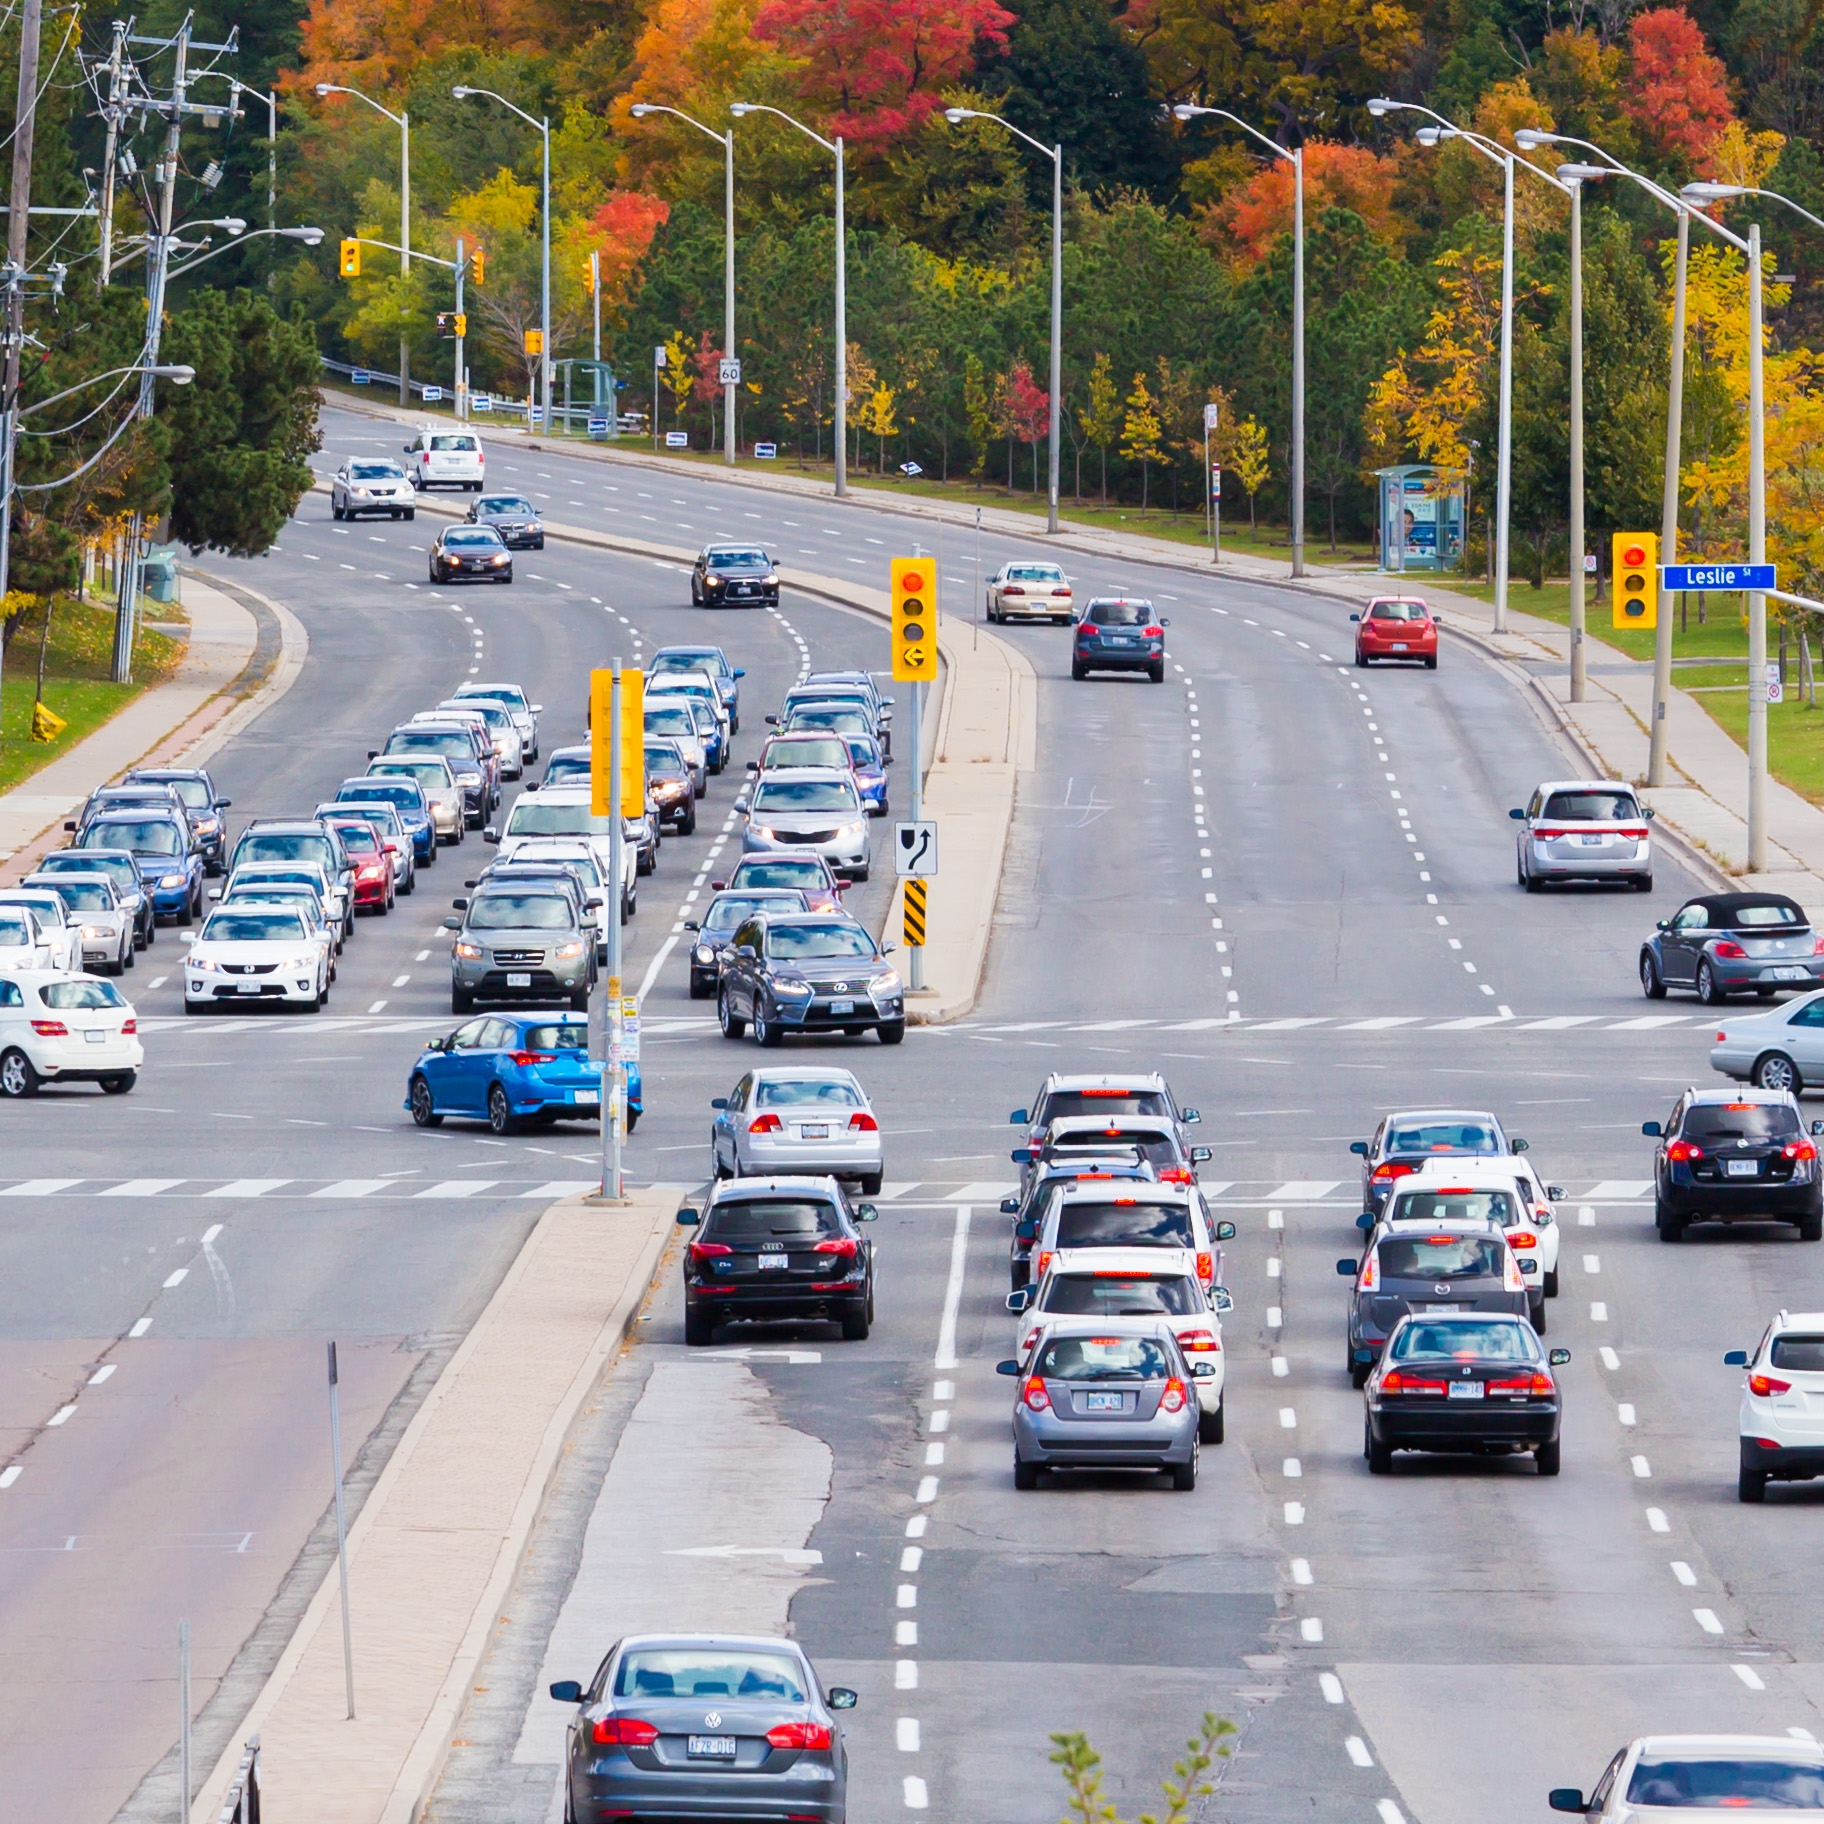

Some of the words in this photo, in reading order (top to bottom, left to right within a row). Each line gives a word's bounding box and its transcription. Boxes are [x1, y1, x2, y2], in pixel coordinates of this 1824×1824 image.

[722, 369, 738, 380] 60
[1687, 567, 1736, 585] Leslie
[1742, 567, 1751, 577] St
